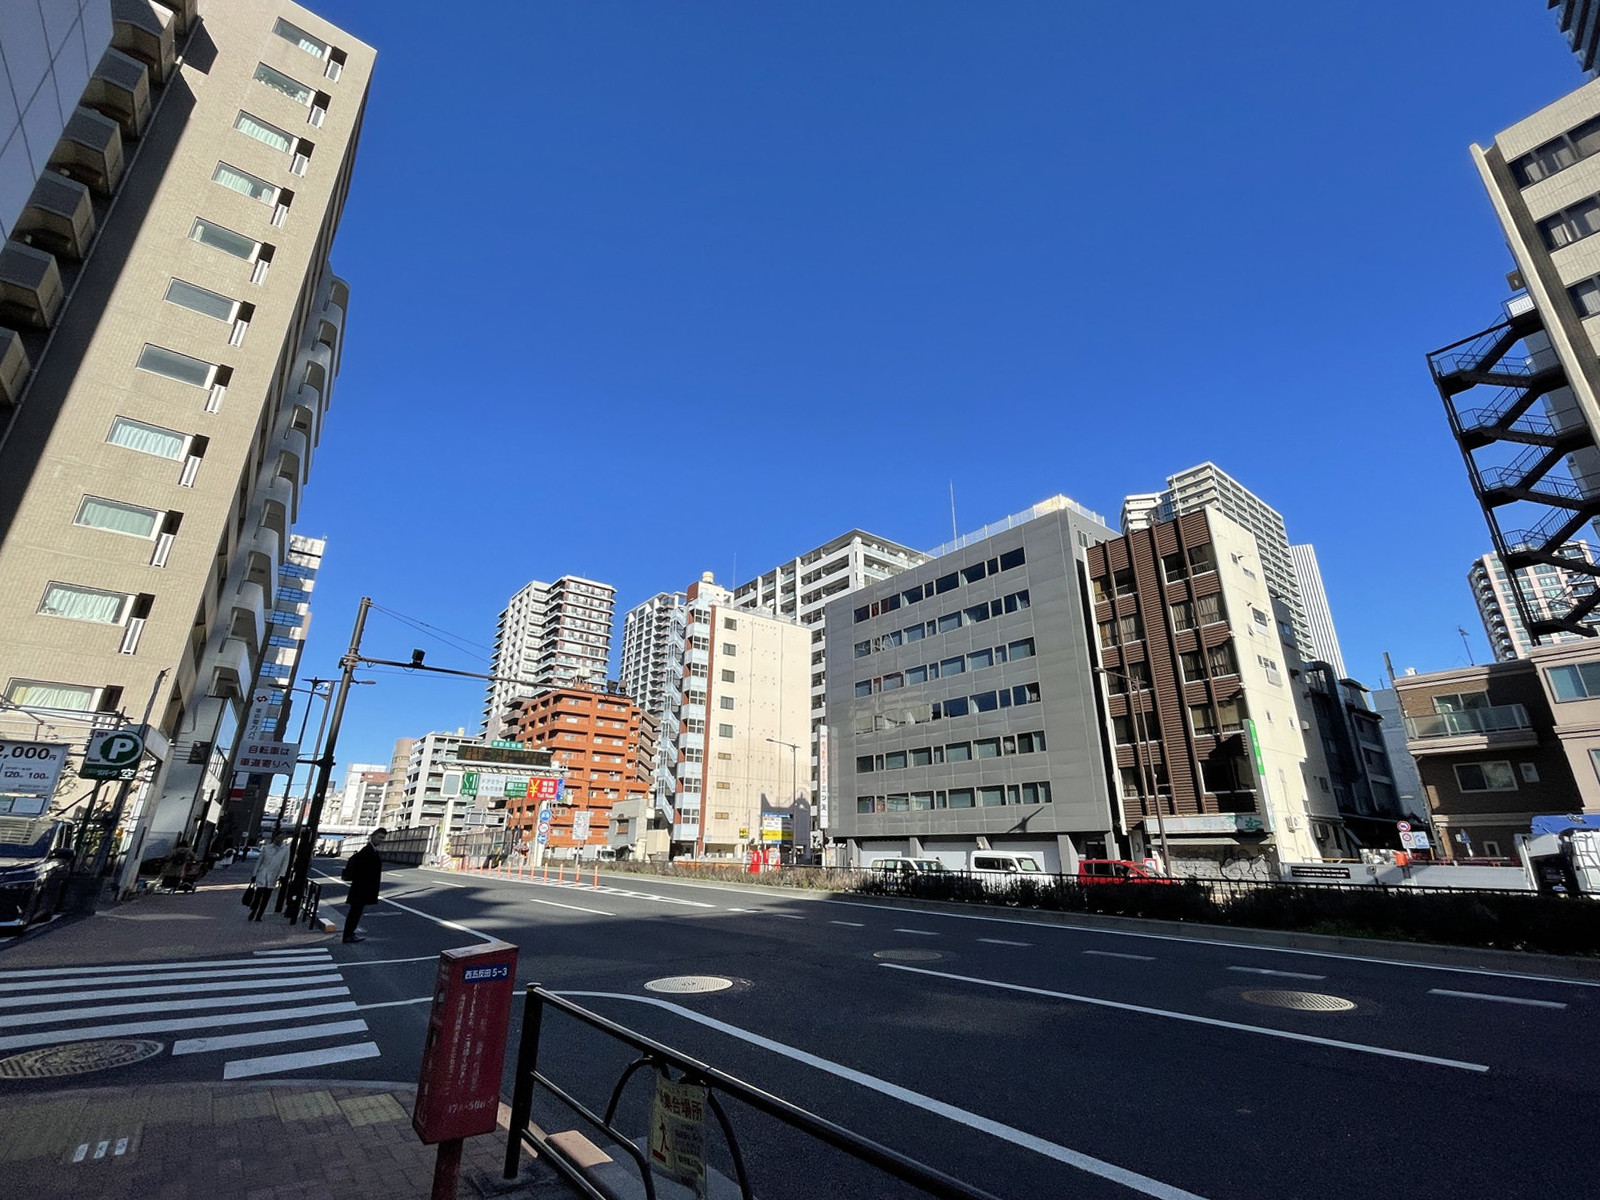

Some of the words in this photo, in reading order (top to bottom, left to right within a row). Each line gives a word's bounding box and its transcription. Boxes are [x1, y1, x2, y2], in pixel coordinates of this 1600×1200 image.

[108, 738, 134, 760] P
[248, 745, 289, 756] 自転車は
[240, 758, 290, 769] 車道寄りへ
[119, 768, 136, 780] 空
